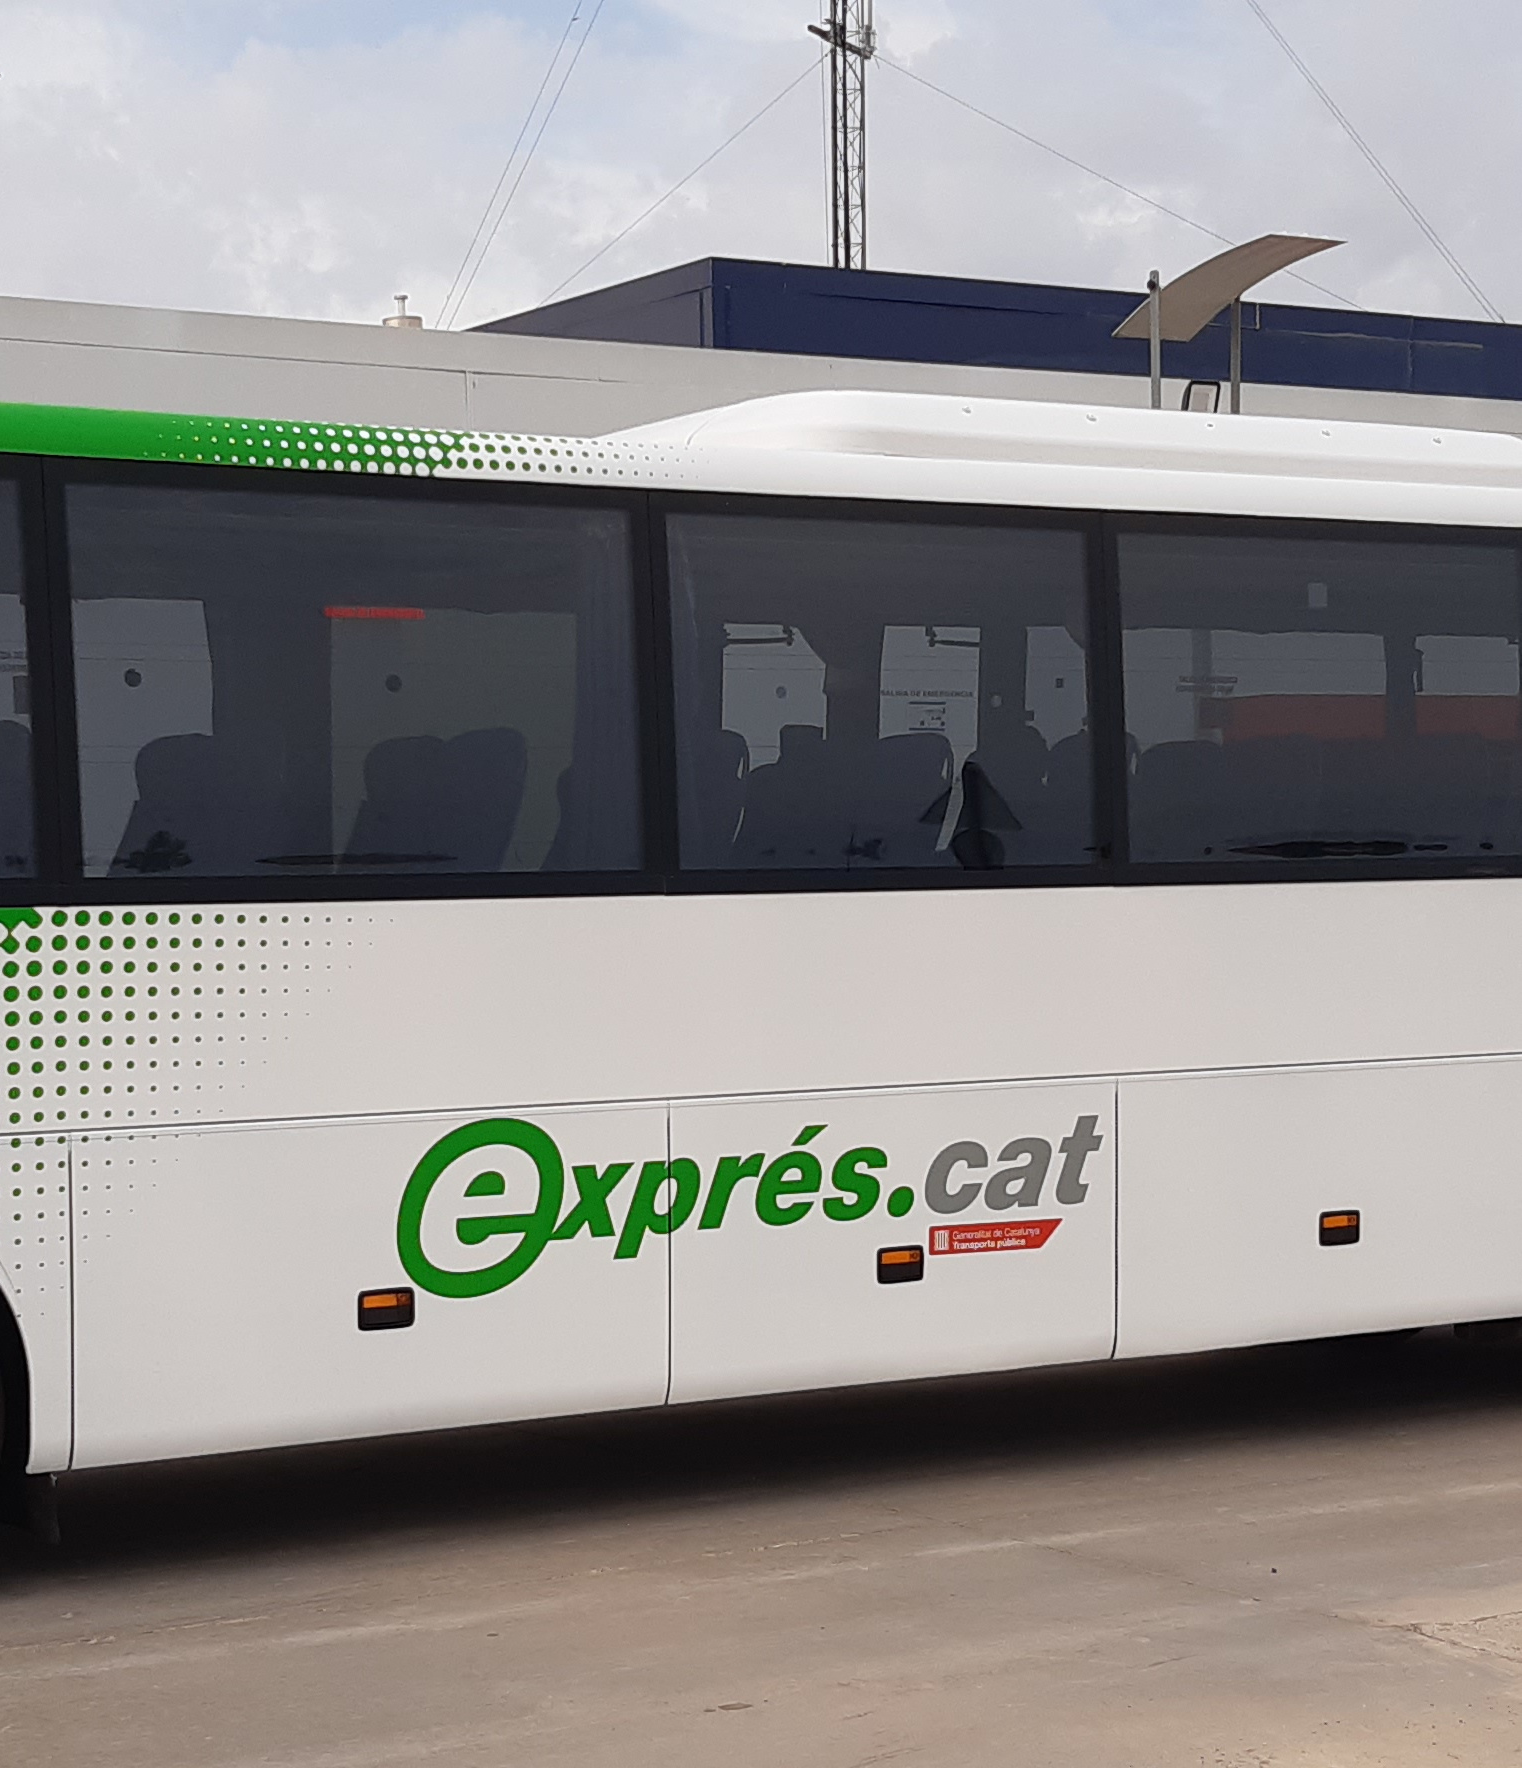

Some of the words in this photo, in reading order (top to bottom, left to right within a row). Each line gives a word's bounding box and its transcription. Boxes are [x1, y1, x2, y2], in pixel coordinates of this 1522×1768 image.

[396, 1115, 1103, 1299] exprés.cat
[952, 1229, 992, 1240] Generalitat
[993, 1228, 1003, 1238] de
[1004, 1226, 1041, 1238] Catalunya
